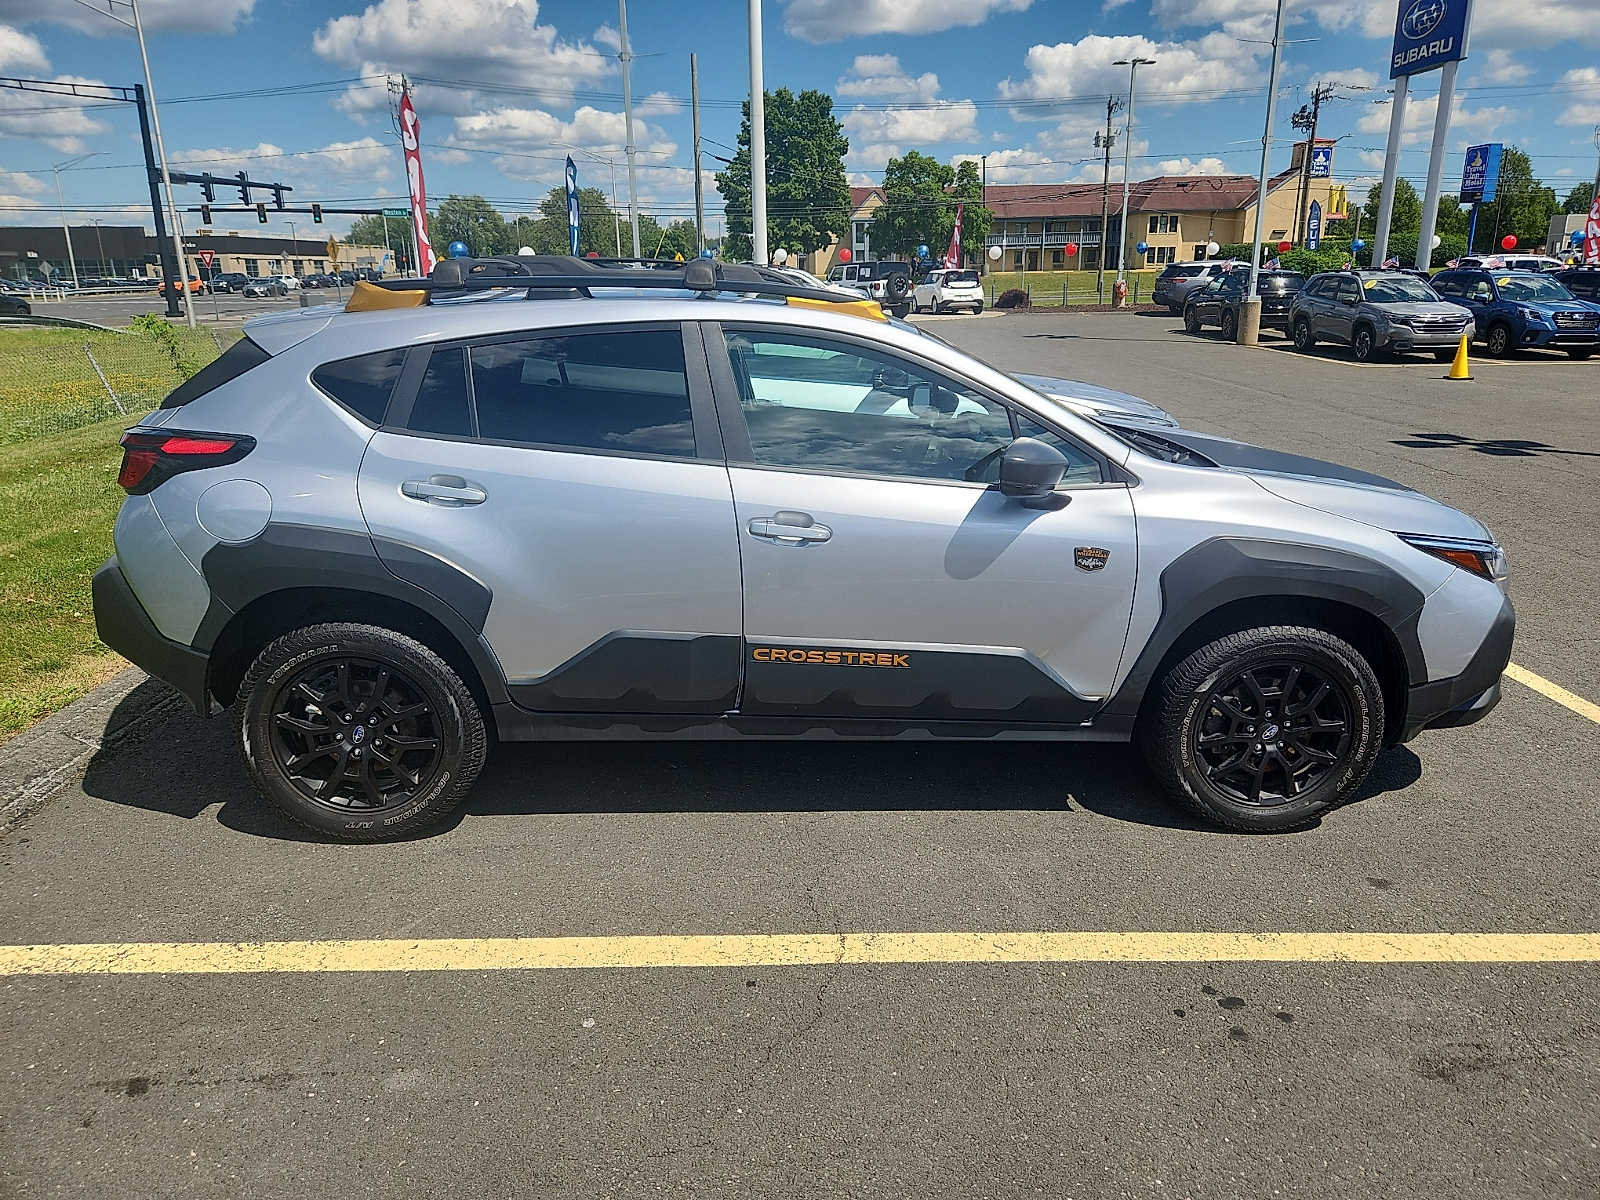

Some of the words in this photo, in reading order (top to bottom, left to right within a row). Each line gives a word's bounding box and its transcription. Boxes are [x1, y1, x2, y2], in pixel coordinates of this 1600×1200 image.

[1394, 36, 1454, 68] SUBARU
[267, 644, 339, 685] YOKOHAMA
[753, 648, 910, 667] CROSSTREK
[1180, 698, 1200, 768] YOKOHAMA
[383, 771, 451, 826] GEOLANDAR
